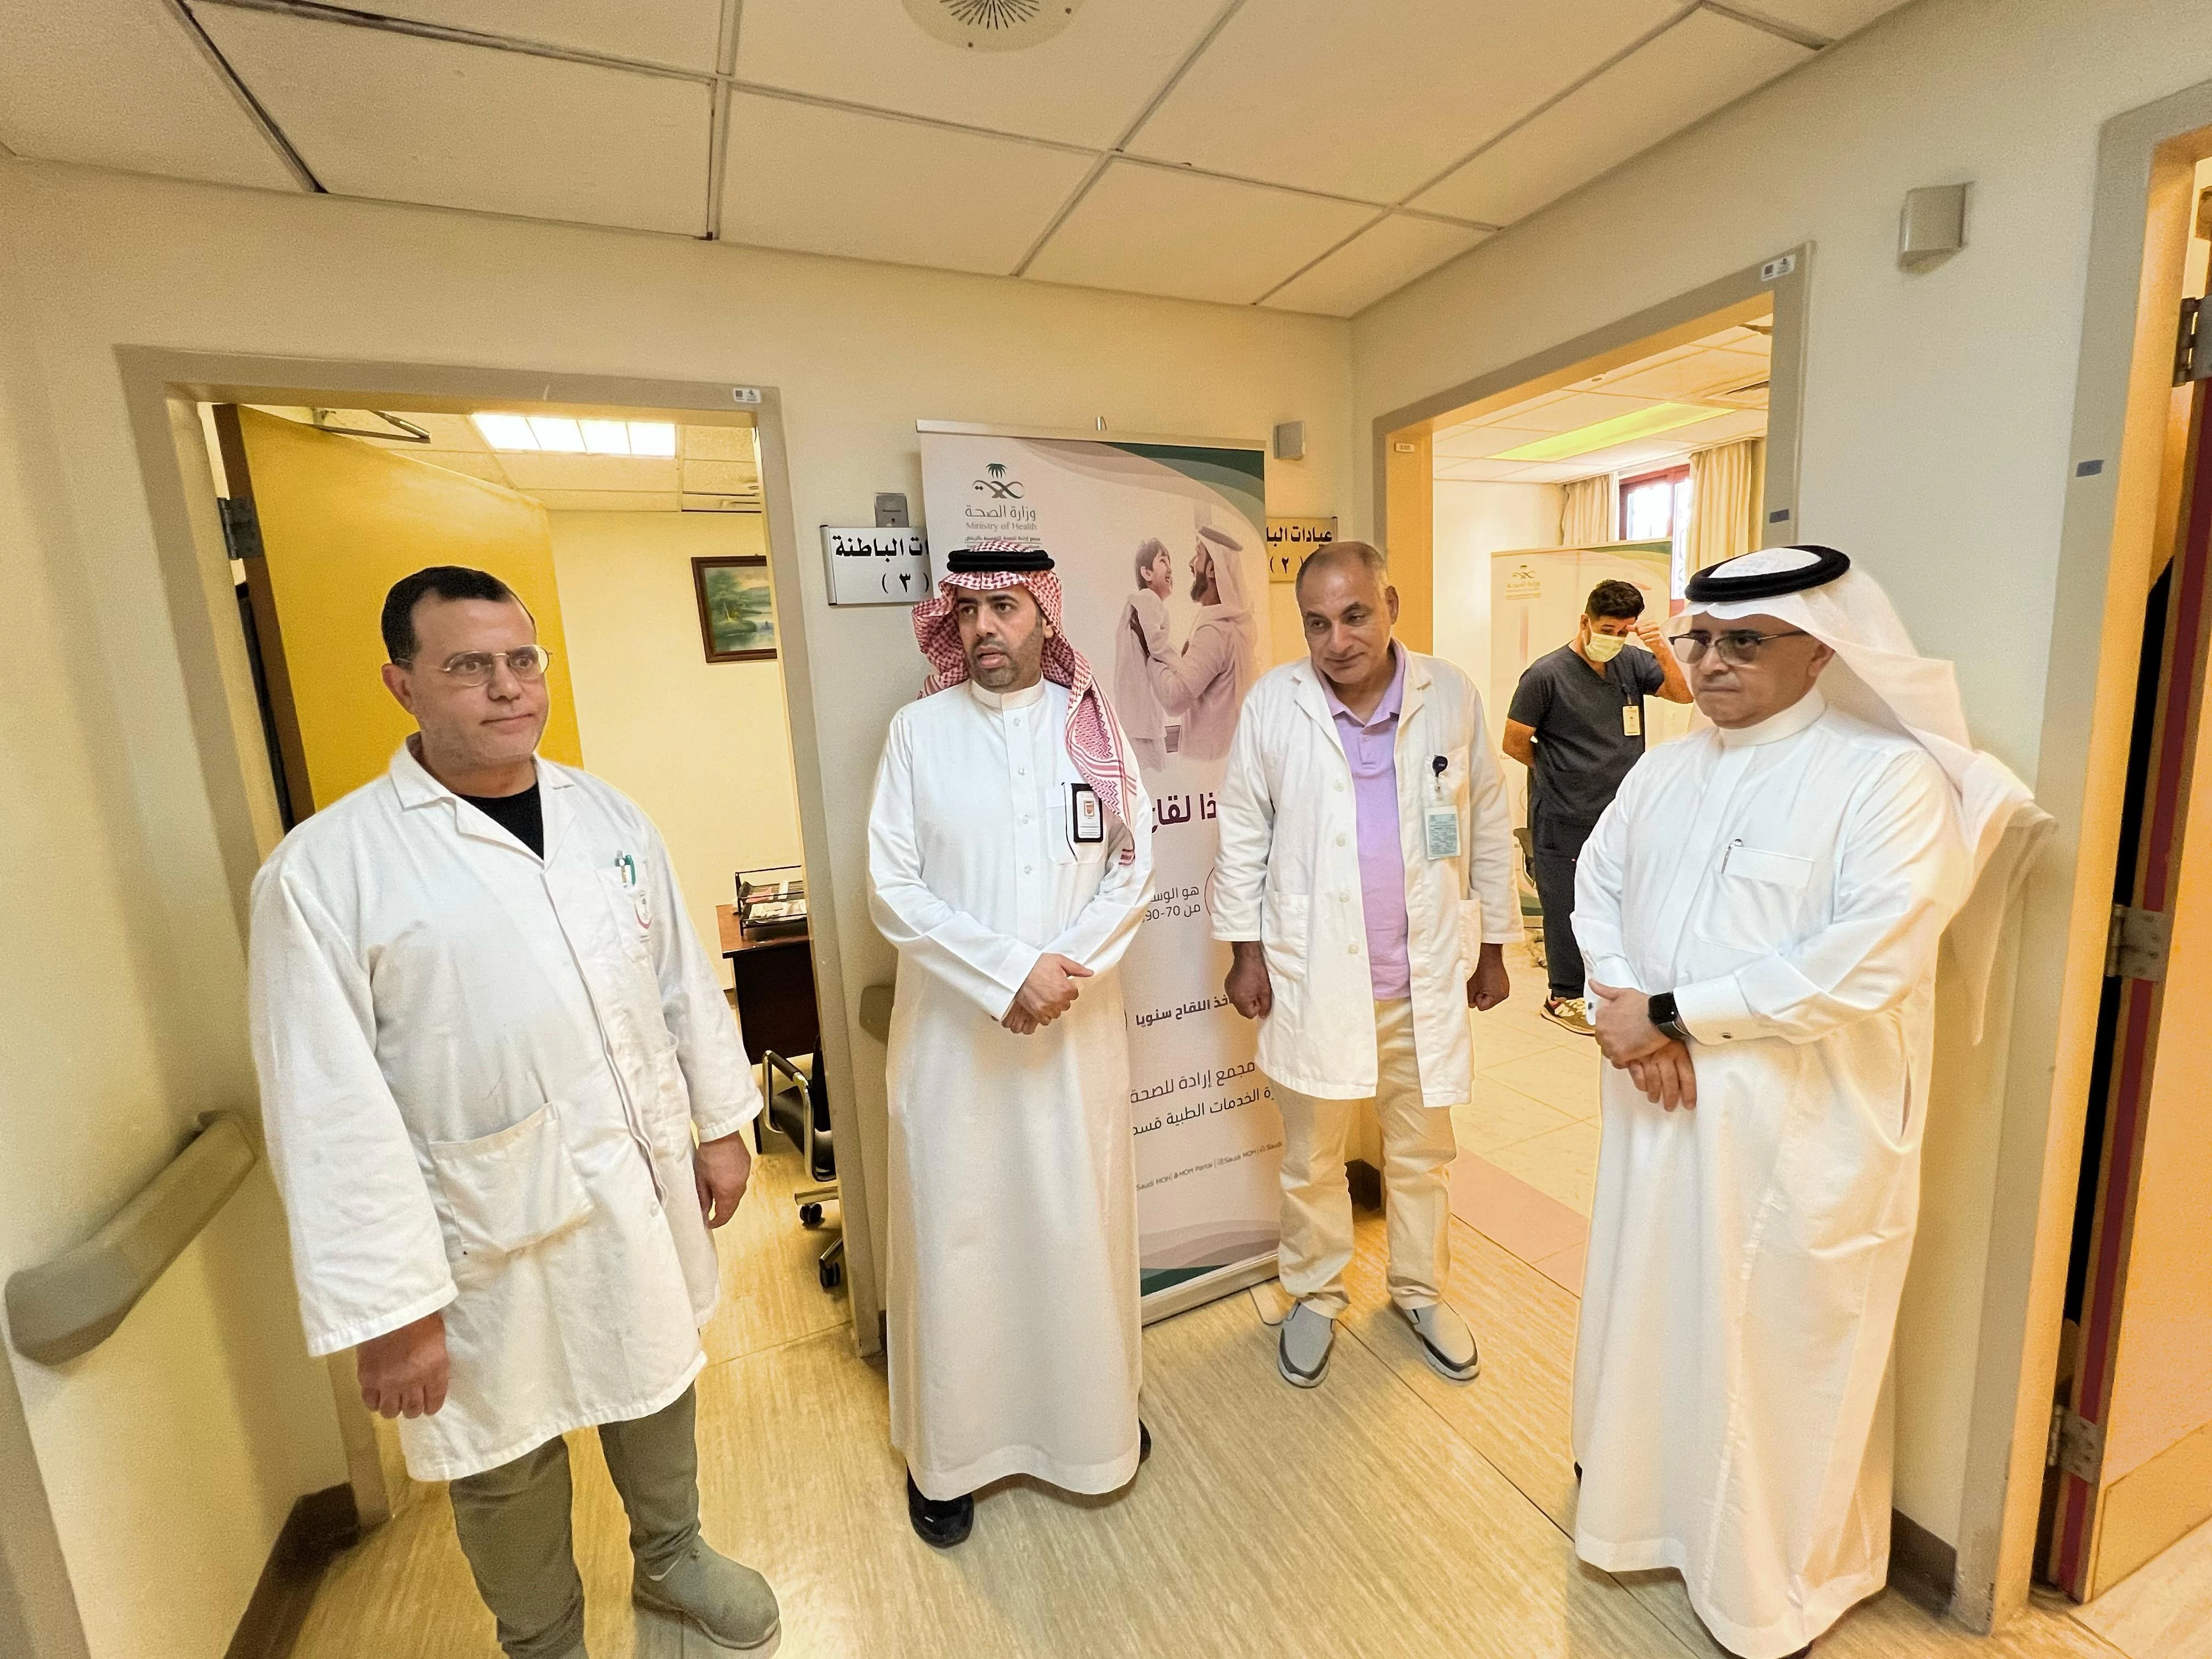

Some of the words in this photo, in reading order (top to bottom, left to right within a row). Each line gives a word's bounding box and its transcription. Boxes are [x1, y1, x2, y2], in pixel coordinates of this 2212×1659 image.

[965, 504, 1006, 518] الصحة
[1010, 505, 1036, 521] وزارة
[966, 522, 998, 532] Ministry
[1001, 522, 1009, 531] of
[1012, 522, 1037, 531] Health
[1266, 526, 1288, 547] البا
[1290, 526, 1333, 548] عيادات
[832, 535, 904, 563] الباطنة
[909, 536, 929, 556] ات
[1199, 792, 1217, 820] ذا
[1150, 887, 1178, 904] الوس
[1182, 886, 1199, 900] هو
[1183, 904, 1201, 918] من
[1175, 999, 1210, 1020] اللقاح
[1214, 994, 1231, 1008] خذ
[1136, 1009, 1172, 1028] سنويا
[1179, 1070, 1212, 1090] إرادة
[1216, 1061, 1256, 1086] مجمع
[1130, 1078, 1175, 1104] للصحة
[1210, 1088, 1260, 1114] الخدمات
[1166, 1102, 1205, 1126] الطبية
[1179, 1167, 1194, 1176] MOH
